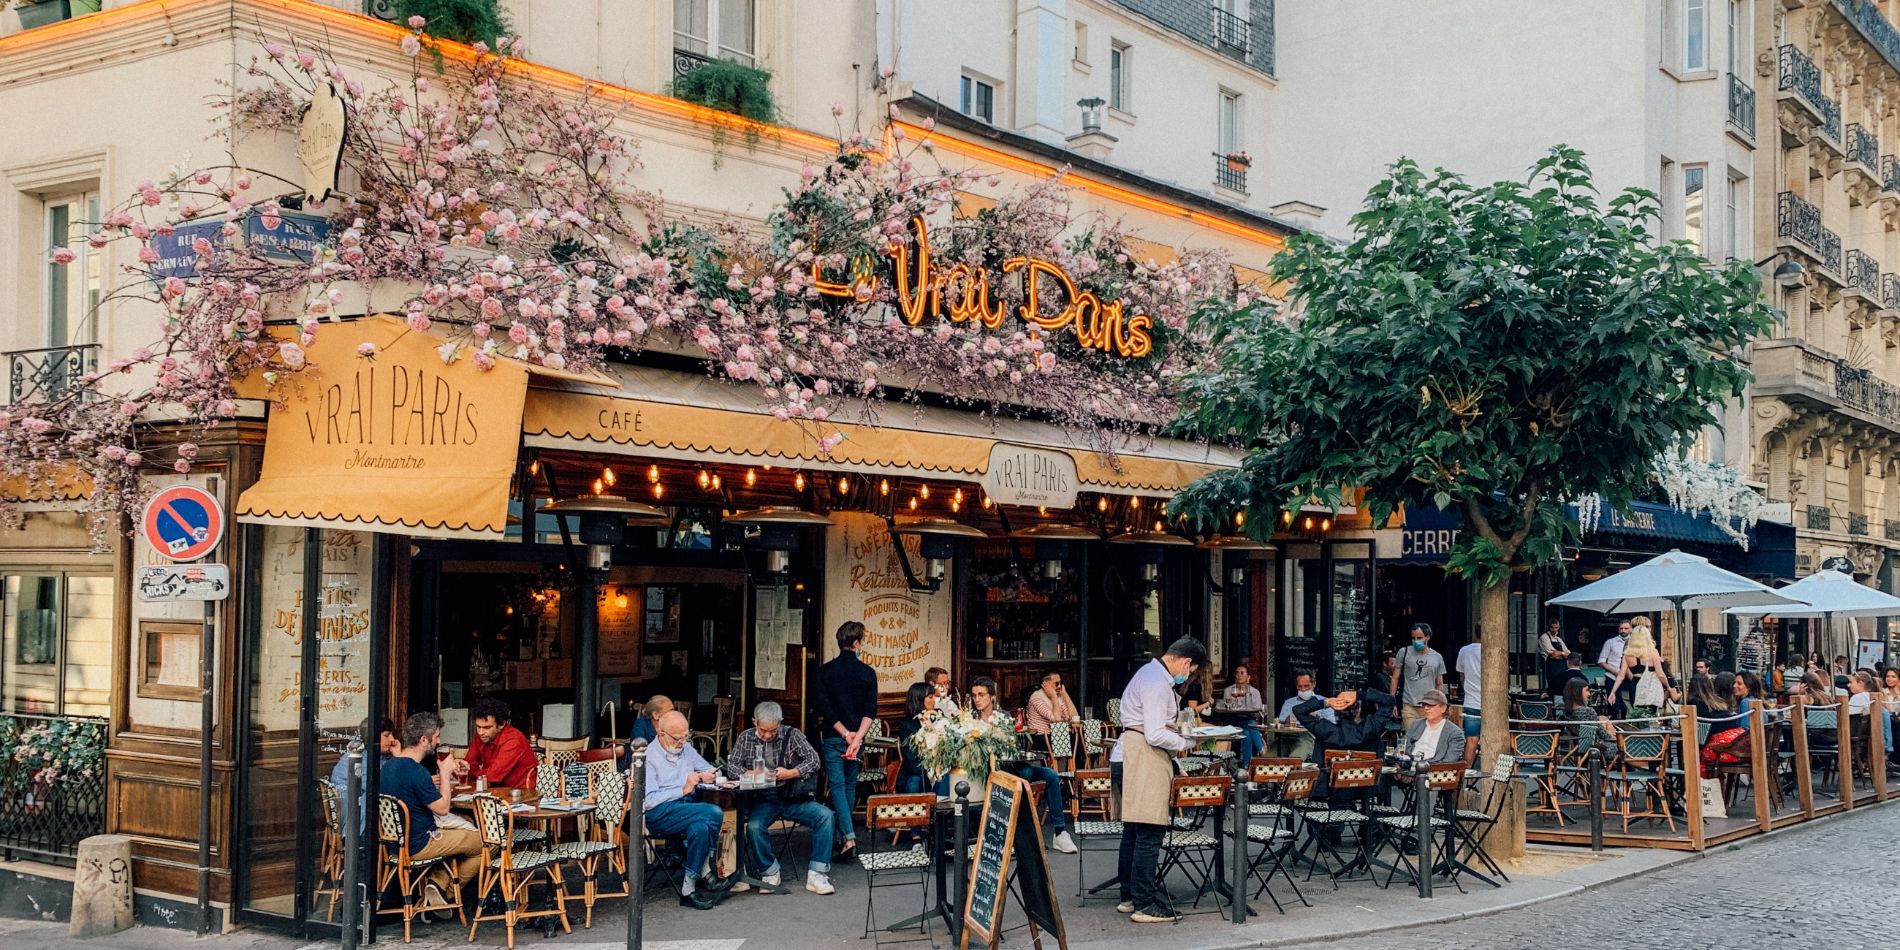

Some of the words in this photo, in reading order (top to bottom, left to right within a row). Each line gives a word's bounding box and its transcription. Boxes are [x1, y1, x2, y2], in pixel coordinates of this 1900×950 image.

[177, 233, 199, 247] RUE
[887, 213, 1005, 330] Vrai
[305, 367, 374, 444] VRAI
[389, 365, 479, 445] PARIS
[598, 409, 643, 432] CAFÉ
[345, 448, 425, 470] Montmartre
[995, 453, 1028, 489] VRAI
[1033, 453, 1068, 493] PARIS
[1611, 507, 1620, 527] LE
[863, 601, 899, 620] PRODUITS
[900, 603, 920, 619] FRAIS
[888, 617, 896, 629] &
[863, 629, 884, 649] FAIT
[885, 628, 919, 649] MAISON
[861, 650, 895, 668] TOUTE
[897, 642, 931, 666] HEURE
